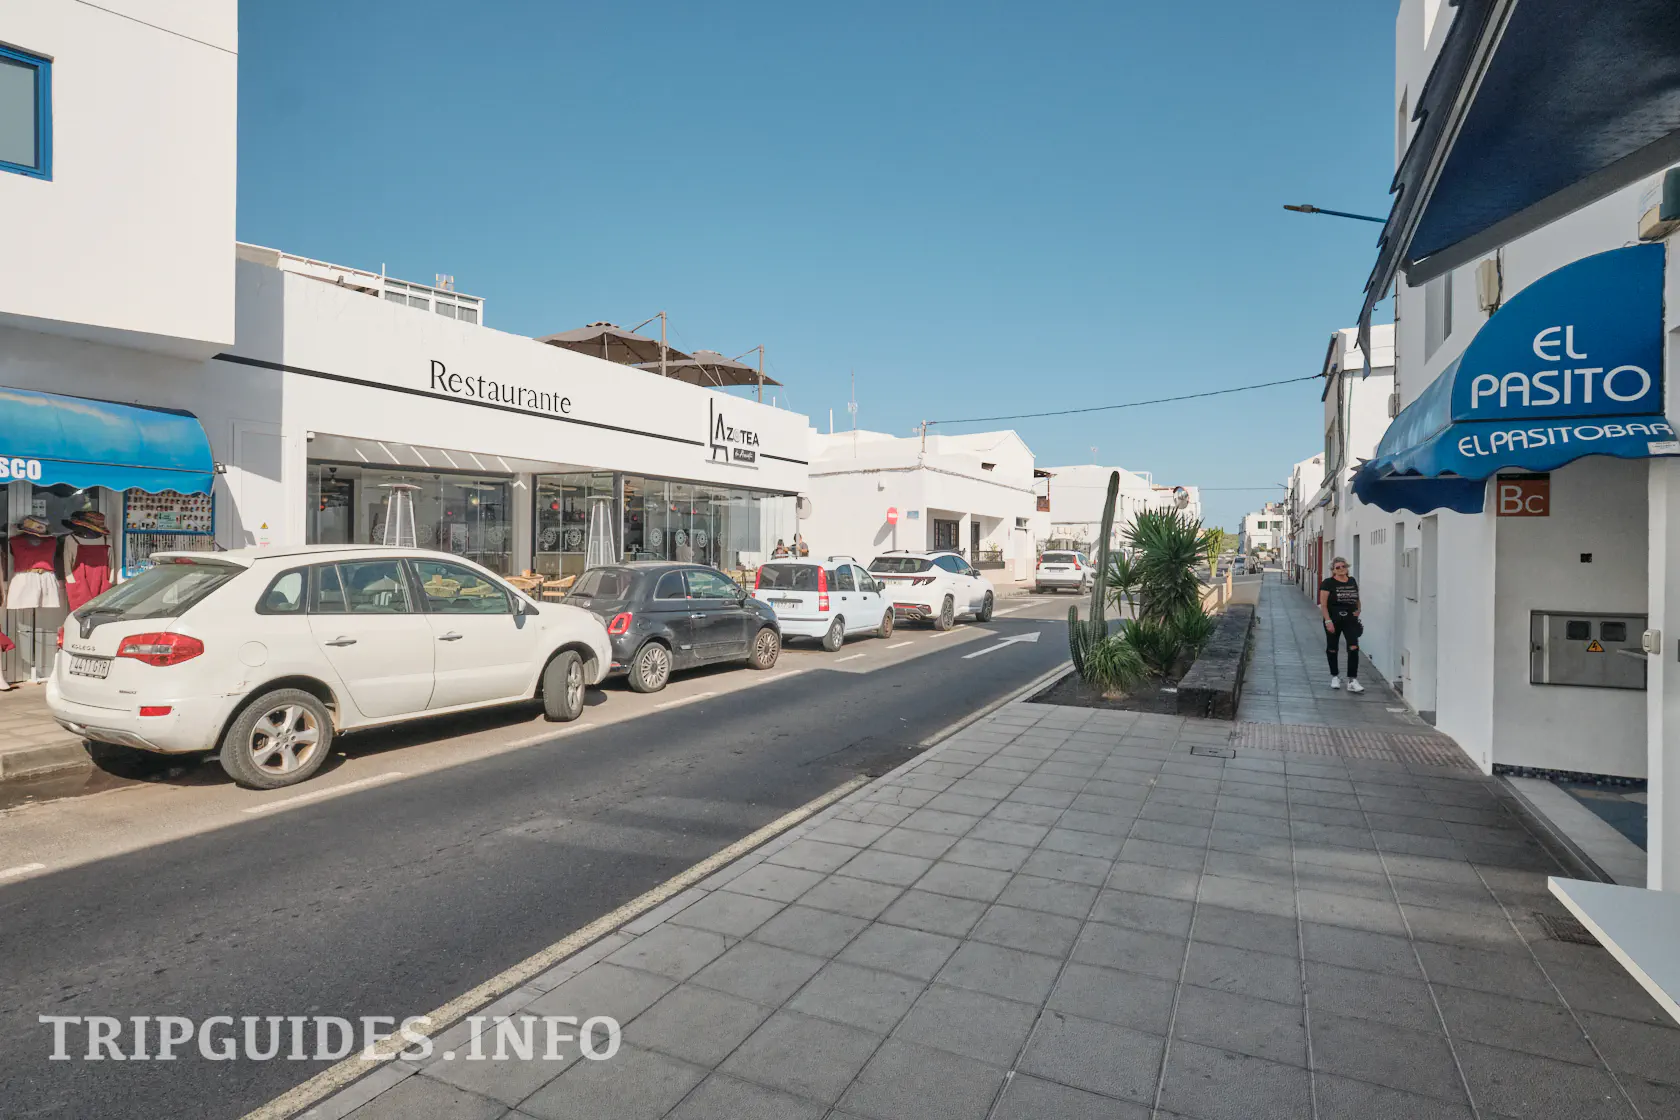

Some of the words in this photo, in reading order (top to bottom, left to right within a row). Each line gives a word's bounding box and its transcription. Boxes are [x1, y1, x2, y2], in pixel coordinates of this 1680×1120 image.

[1532, 325, 1588, 361] EL
[429, 359, 572, 414] Restaurante
[1471, 365, 1652, 409] PASITO
